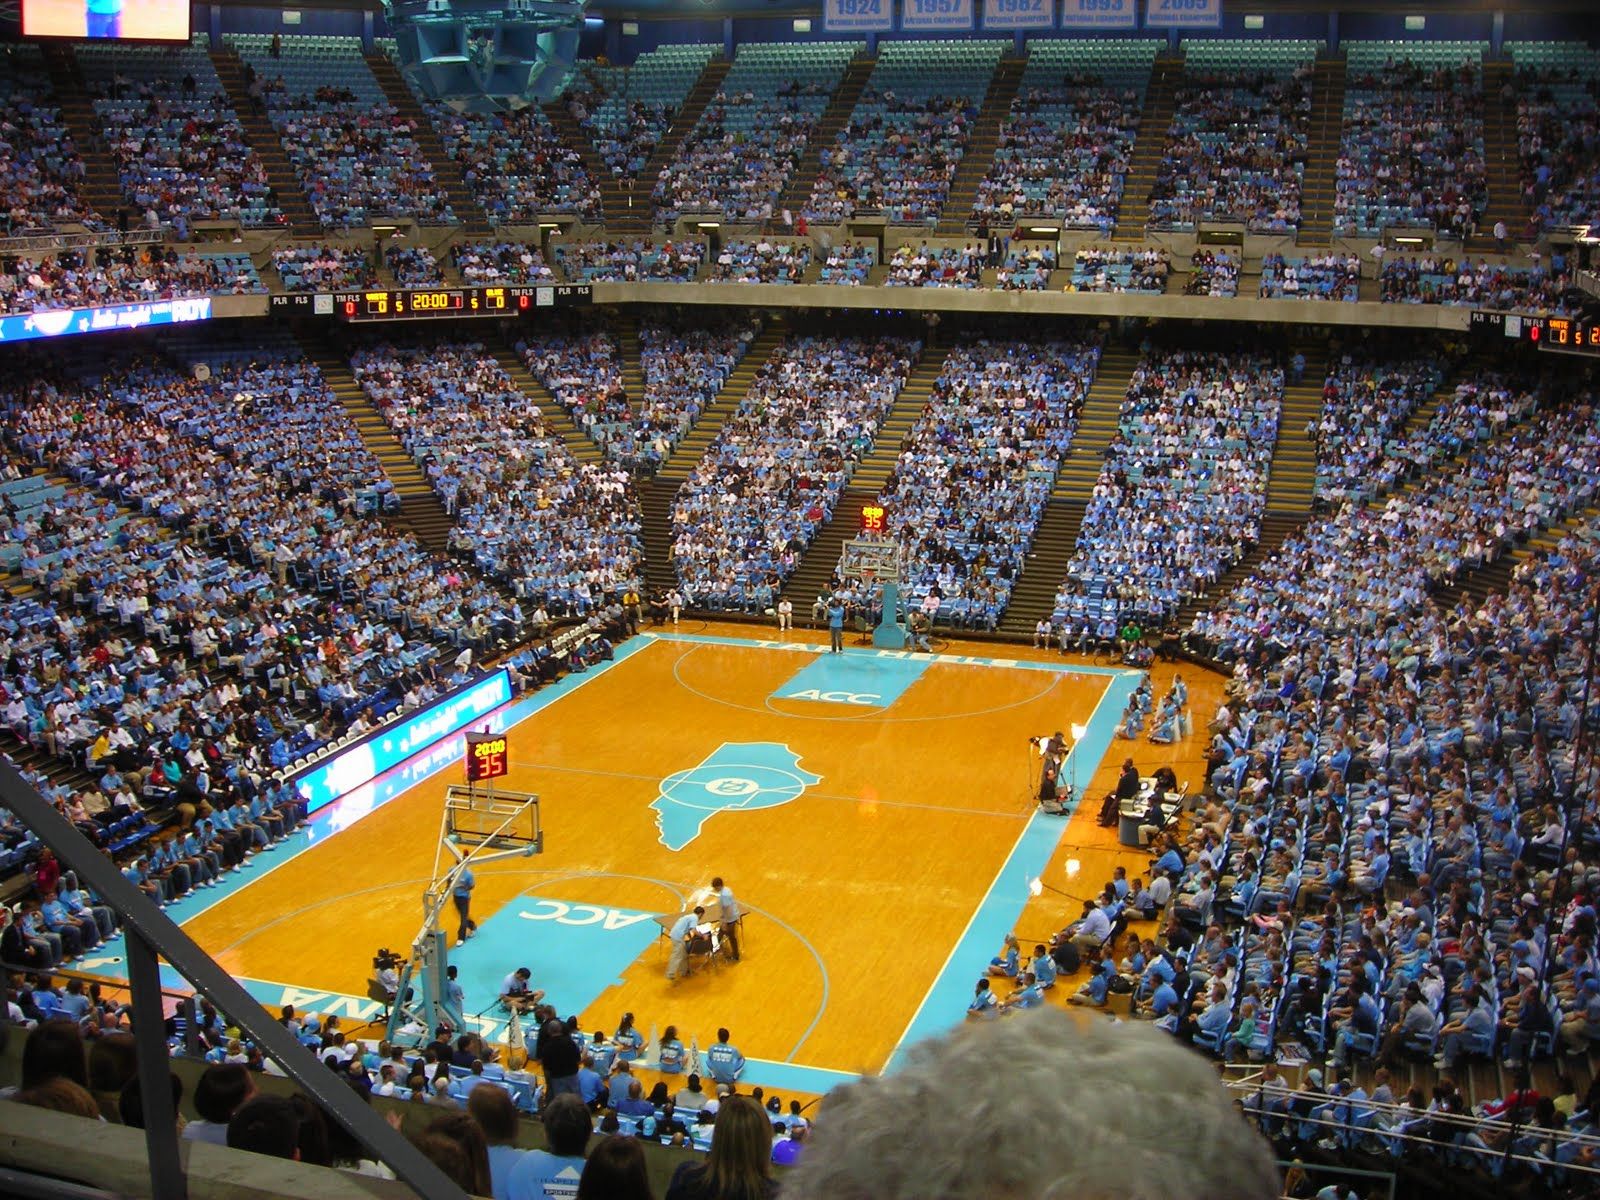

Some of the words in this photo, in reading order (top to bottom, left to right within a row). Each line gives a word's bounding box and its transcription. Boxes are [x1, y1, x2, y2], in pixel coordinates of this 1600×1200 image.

[838, 0, 881, 14] 1924
[916, 0, 961, 13] 1957
[521, 288, 534, 296] FLS
[558, 287, 571, 295] PLR
[577, 286, 589, 294] FLS
[273, 297, 287, 305] PLR
[295, 296, 308, 304] FLS
[336, 294, 346, 302] TM
[347, 294, 360, 302] FLS
[413, 294, 448, 308] 20:00
[496, 296, 504, 309] 0
[520, 296, 528, 308] 0
[172, 297, 210, 322] ROY
[346, 302, 354, 313] 0
[378, 301, 387, 313] 0
[1472, 313, 1484, 322] PLR
[1490, 315, 1501, 324] FLS
[1533, 318, 1544, 328] FLS
[1531, 327, 1539, 341] 0
[1559, 330, 1567, 343] 0
[865, 516, 881, 528] 35
[876, 650, 1018, 668] HEELS
[786, 689, 881, 705] ACC
[474, 739, 506, 757] 20:00
[479, 753, 502, 777] 35
[519, 900, 654, 931] ACC
